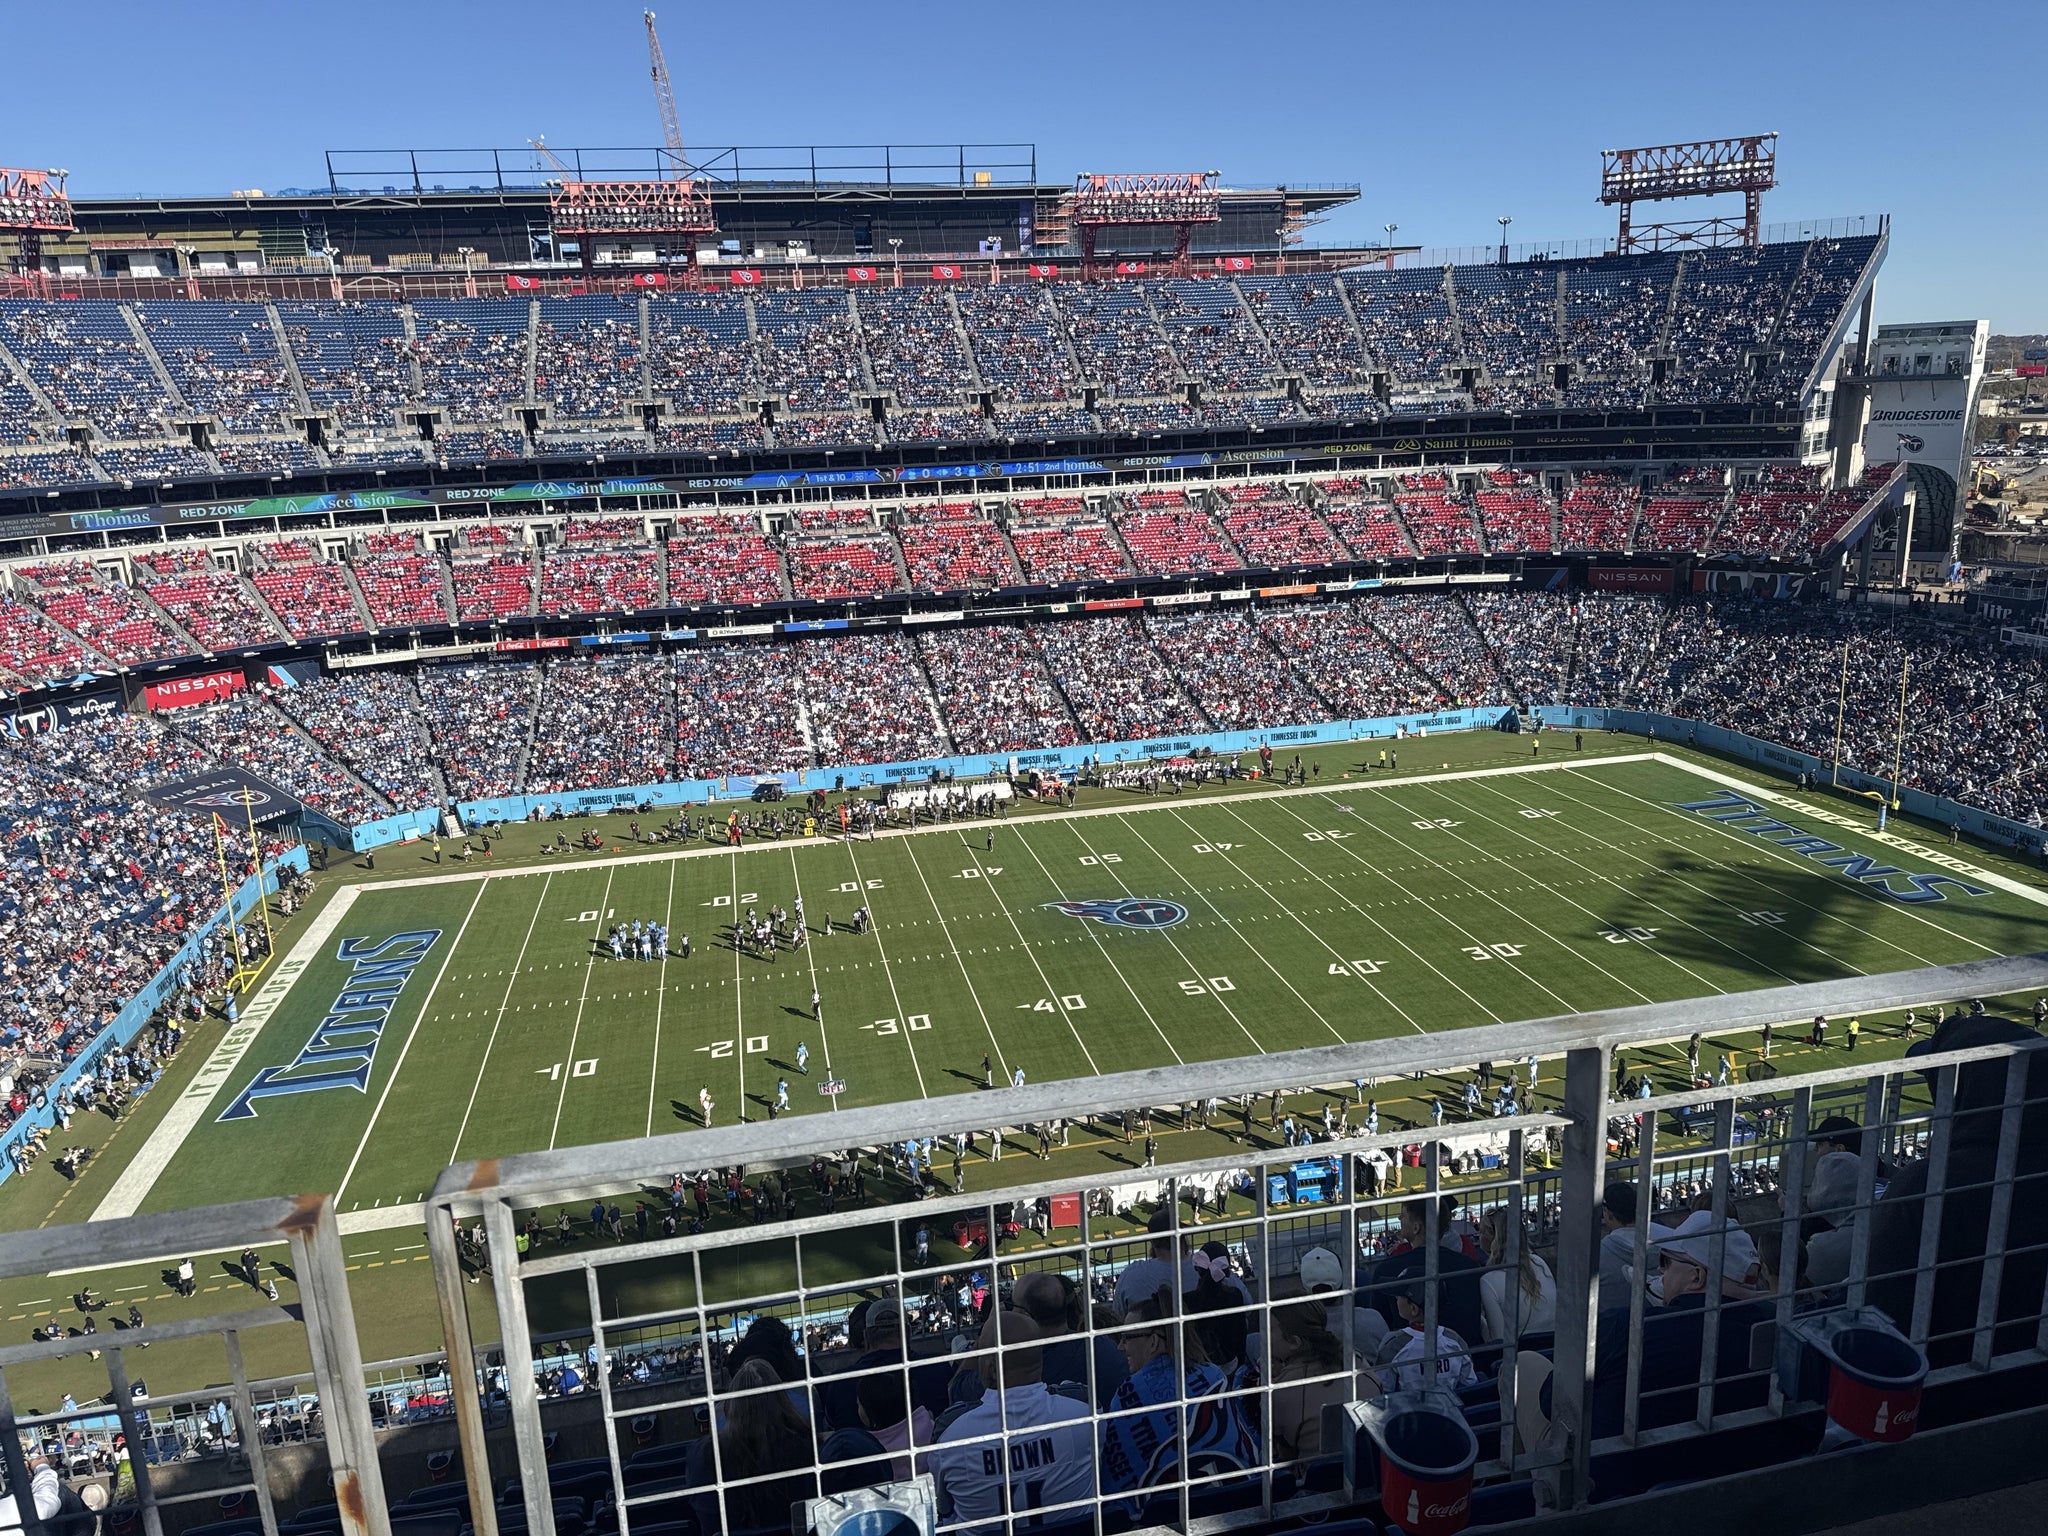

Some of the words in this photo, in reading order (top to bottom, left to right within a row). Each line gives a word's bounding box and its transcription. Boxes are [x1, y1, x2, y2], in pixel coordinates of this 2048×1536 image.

[1872, 409, 1964, 421] BRIDGESTONE
[1324, 445, 1342, 453] RED
[1344, 443, 1372, 452] ZONE
[1425, 436, 1460, 449] Saint
[1462, 435, 1514, 448] Thomas
[1123, 457, 1142, 466] RED
[1144, 456, 1172, 465] ZONE
[1223, 448, 1285, 462] Ascension
[922, 468, 930, 479] 0
[954, 467, 962, 477] 3
[1016, 462, 1040, 473] 2:51
[1044, 463, 1060, 471] 2nd
[689, 479, 710, 489] RED
[712, 478, 743, 487] ZONE
[816, 474, 827, 483] 1st
[836, 473, 846, 482] 10
[446, 490, 470, 499] RED
[472, 488, 505, 498] ZONE
[567, 481, 602, 496] Saint
[603, 480, 665, 494] Thomas
[316, 493, 396, 510] Ascension
[179, 507, 207, 518] RED
[209, 505, 246, 516] ZONE
[80, 513, 151, 528] Thomas
[1598, 572, 1662, 583] NISSAN
[447, 655, 473, 663] HONOR
[157, 674, 233, 697] NISSAN
[83, 699, 117, 717] Kroger
[1416, 718, 1444, 728] TENNESSEE
[1444, 716, 1462, 725] TOUGH
[1270, 732, 1299, 742] TENNESSEE
[1300, 730, 1318, 739] TOUGH
[1143, 743, 1172, 753] TENNESSEE
[1173, 741, 1191, 751] TOUGH
[1018, 755, 1042, 765] NNESSEE
[885, 766, 916, 778] TENNESSEE
[162, 778, 237, 801] NISSAN
[578, 794, 613, 805] TENNESSEE
[614, 793, 636, 803] TOUGH
[252, 809, 286, 824] NISSAN
[1518, 808, 1557, 819] 10
[1410, 818, 1458, 830] 20
[1303, 830, 1349, 842] 30
[1774, 796, 1846, 826] SALUTE
[1881, 835, 1986, 876] SERVICE
[1192, 842, 1233, 854] 40
[1668, 789, 1996, 904] TITANS
[1078, 853, 1123, 866] 50
[961, 866, 1004, 879] 40
[840, 879, 885, 893] 30
[712, 893, 758, 907] 20
[577, 908, 616, 923] 10
[1737, 910, 1787, 926] 10
[1596, 926, 1657, 945] 20
[1461, 942, 1524, 962] 30
[277, 960, 306, 975] US
[1328, 959, 1383, 978] 40
[262, 979, 291, 994] OF
[1177, 976, 1237, 996] 50
[242, 997, 279, 1021] ALL
[1033, 994, 1088, 1014] 40
[214, 929, 444, 1123] TITANS
[874, 1014, 933, 1036] 30
[200, 1026, 256, 1077] TAKES
[710, 1035, 769, 1059] 20
[550, 1058, 599, 1081] 10
[184, 1084, 217, 1099] IT
[822, 1084, 844, 1096] NFL
